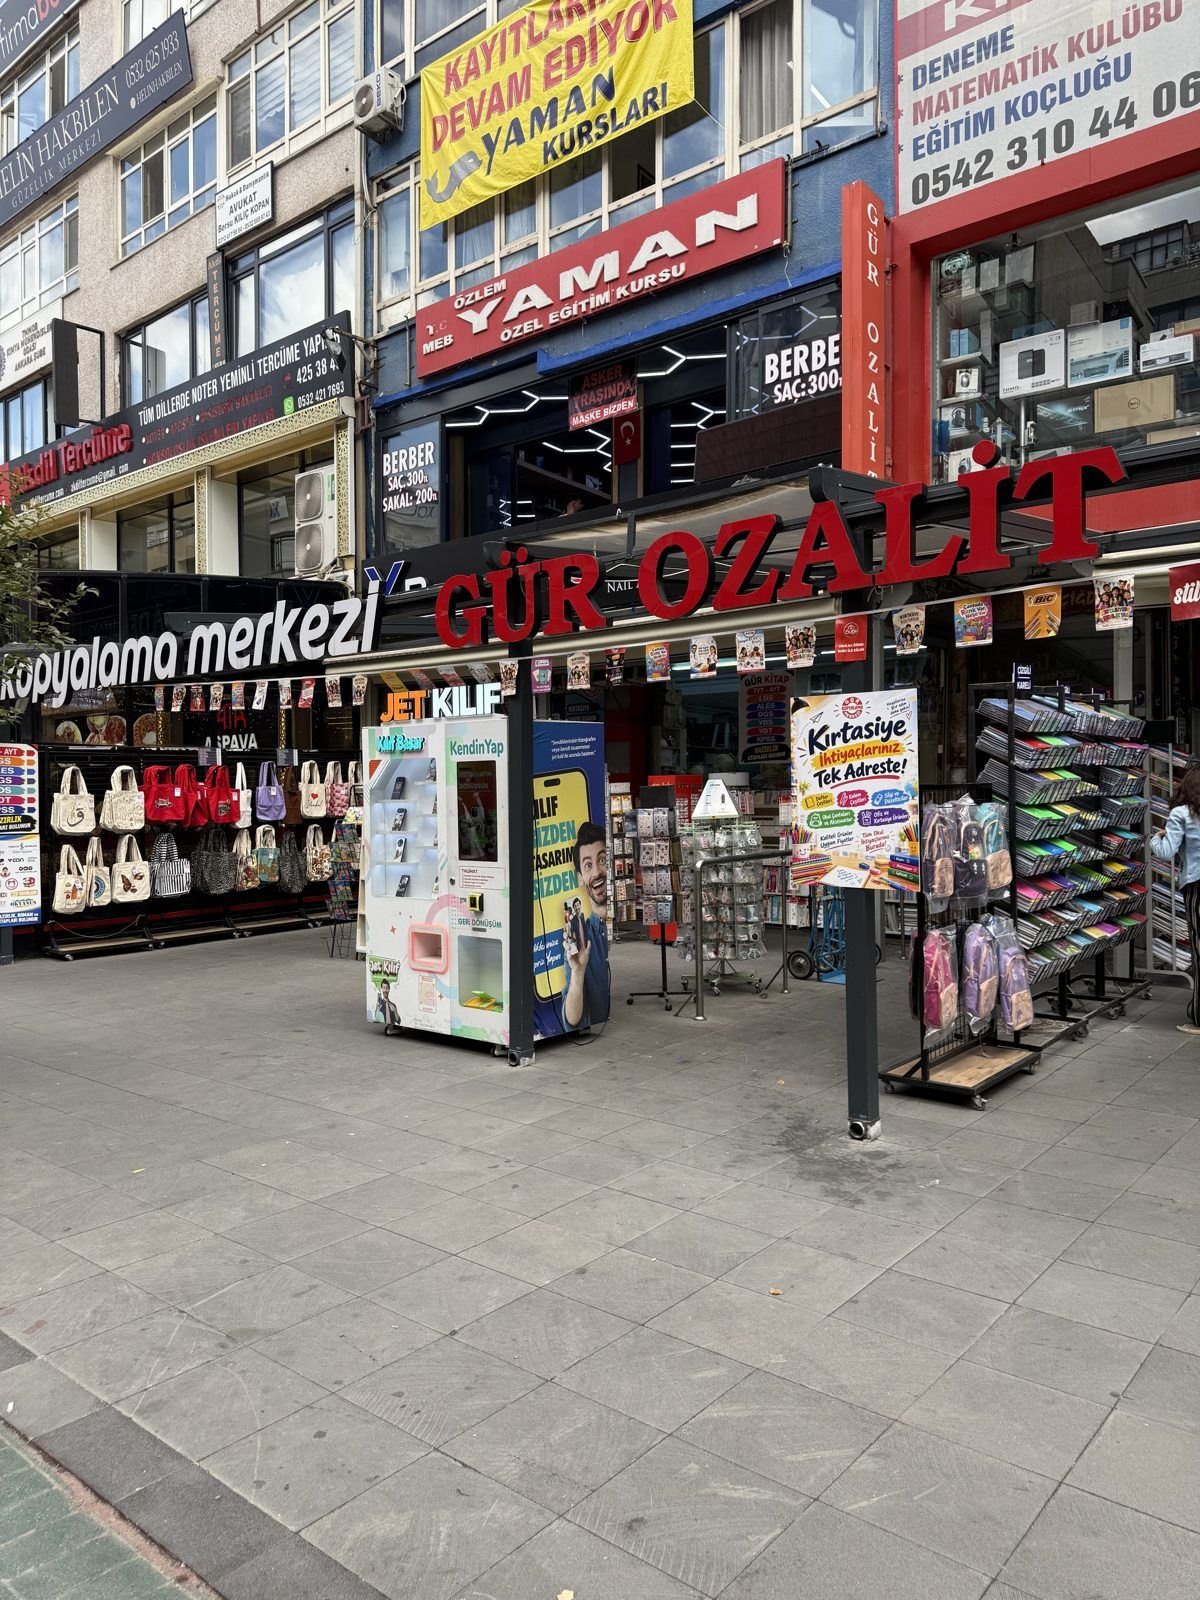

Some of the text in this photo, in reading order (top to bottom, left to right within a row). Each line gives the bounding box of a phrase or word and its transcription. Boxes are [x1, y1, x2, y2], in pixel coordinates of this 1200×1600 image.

[125, 31, 180, 89] 0532 625 1933
[444, 0, 603, 97] KAYITLAR
[912, 24, 1015, 92] DENEME
[431, 0, 679, 154] DEVAM EDİYOR
[912, 42, 1058, 126] MATEMATİK
[481, 65, 616, 175] YAMAN
[542, 82, 668, 165] KURSLARI
[912, 51, 1132, 162] EĞİTİM KOÇLUĞU
[0, 76, 120, 199] ELİN HAKBİLEN
[911, 70, 1200, 206] 0542 310 44 06
[228, 191, 257, 216] AVUKAT
[456, 192, 758, 335] YAMAN
[866, 202, 880, 288] GÜR
[212, 270, 221, 358] TERCÜME
[422, 262, 687, 355] MEB ÖZEL EĞİTİM KURSU
[454, 279, 507, 311] ÖZLEM
[138, 406, 155, 427] TÜM
[156, 390, 190, 423] DİLLERDE
[191, 378, 218, 404] NOTER
[219, 360, 255, 392] YEMİNLİ
[256, 343, 301, 377] TERCÜME
[296, 363, 313, 384] 425
[315, 358, 328, 378] 38
[582, 363, 624, 390] ASKER
[764, 333, 841, 385] BERBE
[297, 380, 345, 409] 0532 421 7693
[572, 400, 634, 426] MASKE BİZDEN
[58, 423, 131, 475] Tercüme
[382, 441, 435, 477] BERBER
[435, 438, 1127, 648] GÜR OZALİT
[1173, 580, 1200, 605] stil
[380, 682, 502, 722] JET KILIF
[744, 672, 790, 687] GÜR KİTAP
[4, 748, 18, 756] AYT
[449, 738, 504, 758] KendinYap
[808, 716, 907, 756] Kırtasiye
[819, 743, 901, 767] İhtiyaçlarınız
[813, 758, 908, 788] Tek Adreste!
[533, 795, 559, 820] ILIF
